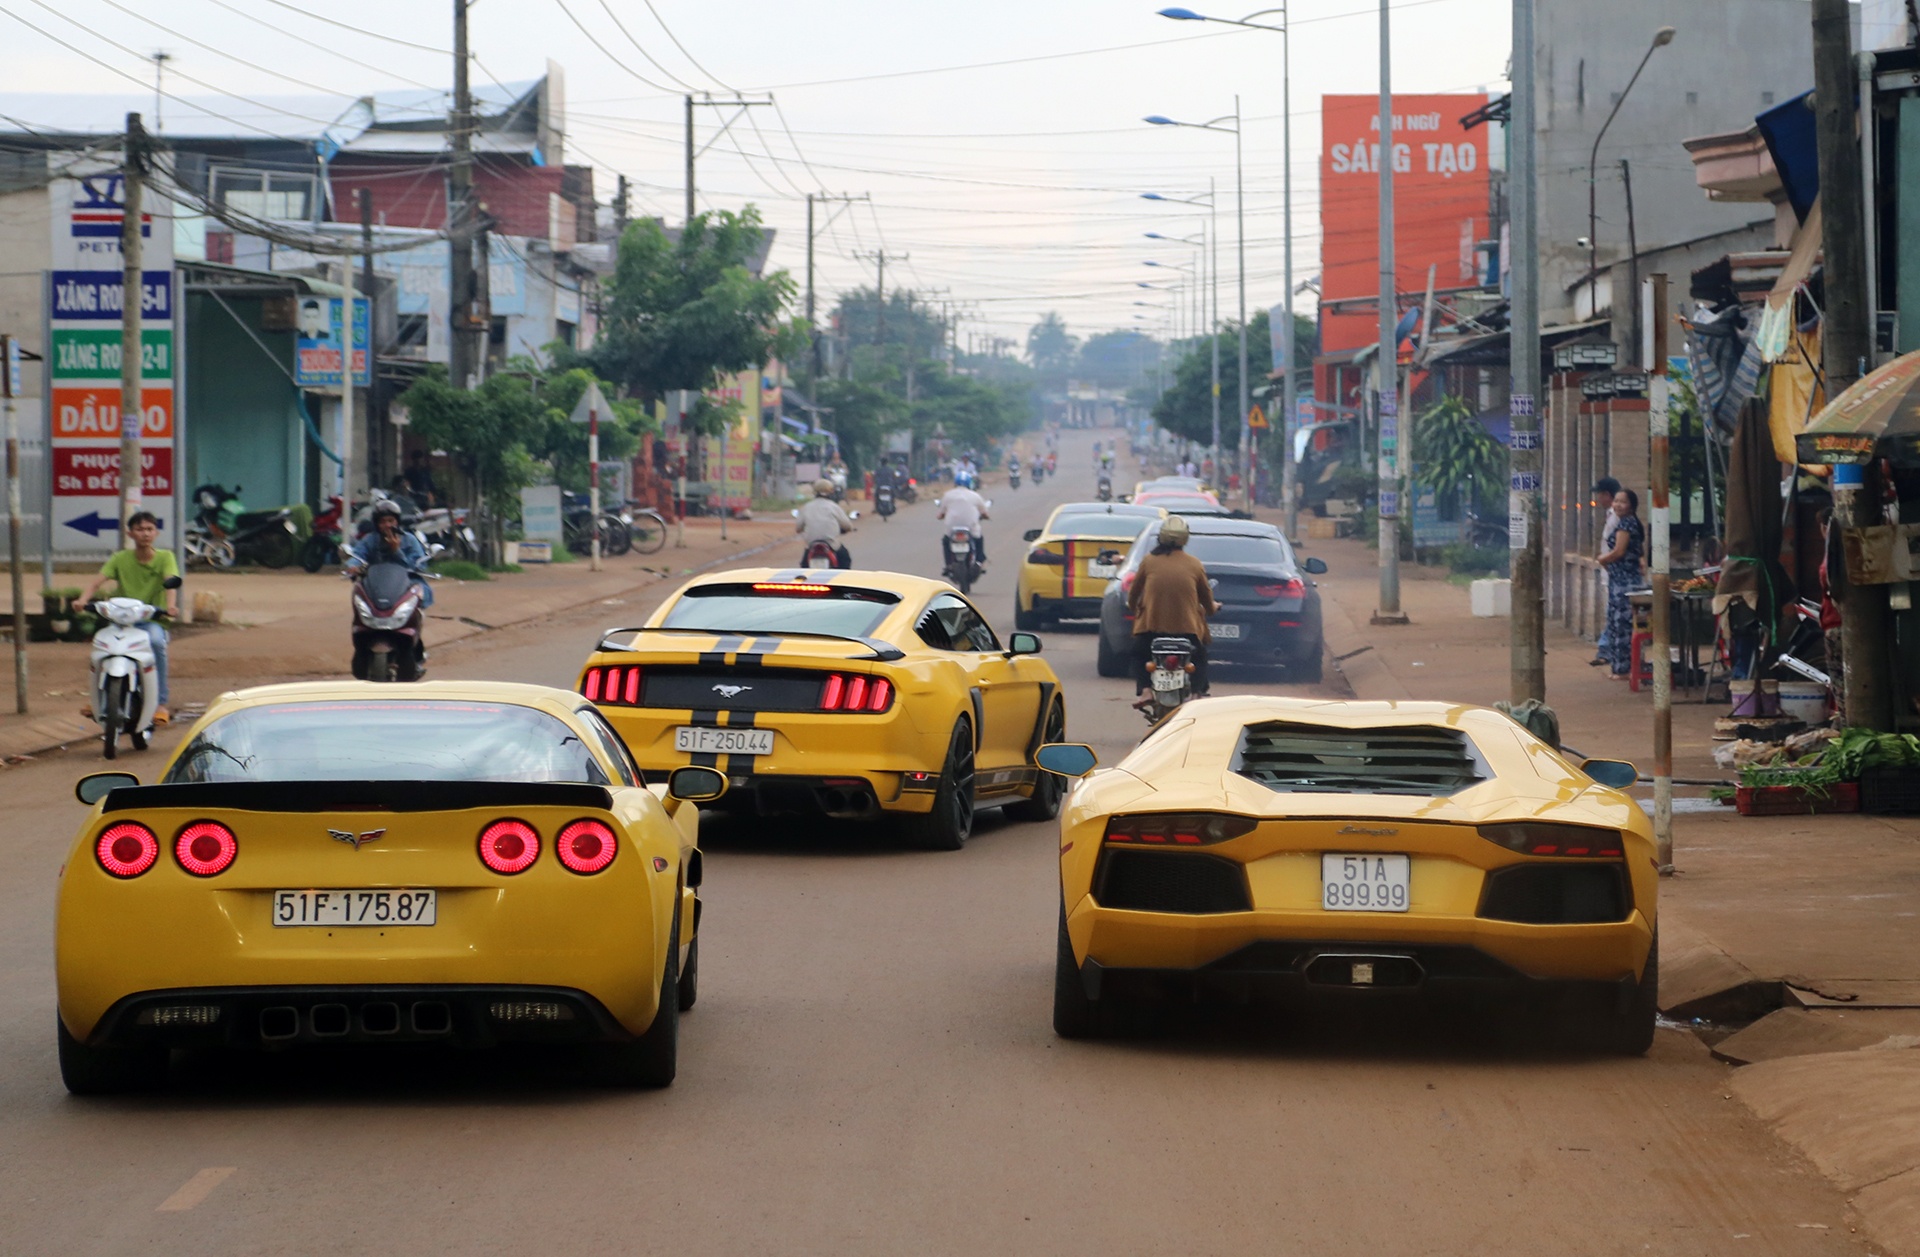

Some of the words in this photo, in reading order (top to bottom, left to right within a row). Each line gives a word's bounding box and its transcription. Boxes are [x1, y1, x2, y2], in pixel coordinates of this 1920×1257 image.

[1370, 114, 1403, 131] AH
[1406, 112, 1441, 130] NGỮ
[1423, 142, 1477, 178] TẠO
[56, 279, 97, 311] XĂNG
[100, 284, 123, 311] RO
[332, 305, 366, 323] HT
[57, 339, 98, 370] XĂNG
[100, 343, 122, 370] RO
[60, 393, 119, 432] DẦU
[71, 453, 121, 471] PHỤC
[58, 475, 82, 489] 5h
[141, 476, 169, 489] 1h
[679, 730, 768, 751] 51F-250.44
[1343, 857, 1387, 881] 51A
[1326, 882, 1406, 907] 899.99
[278, 893, 431, 922] 51F-175.87
